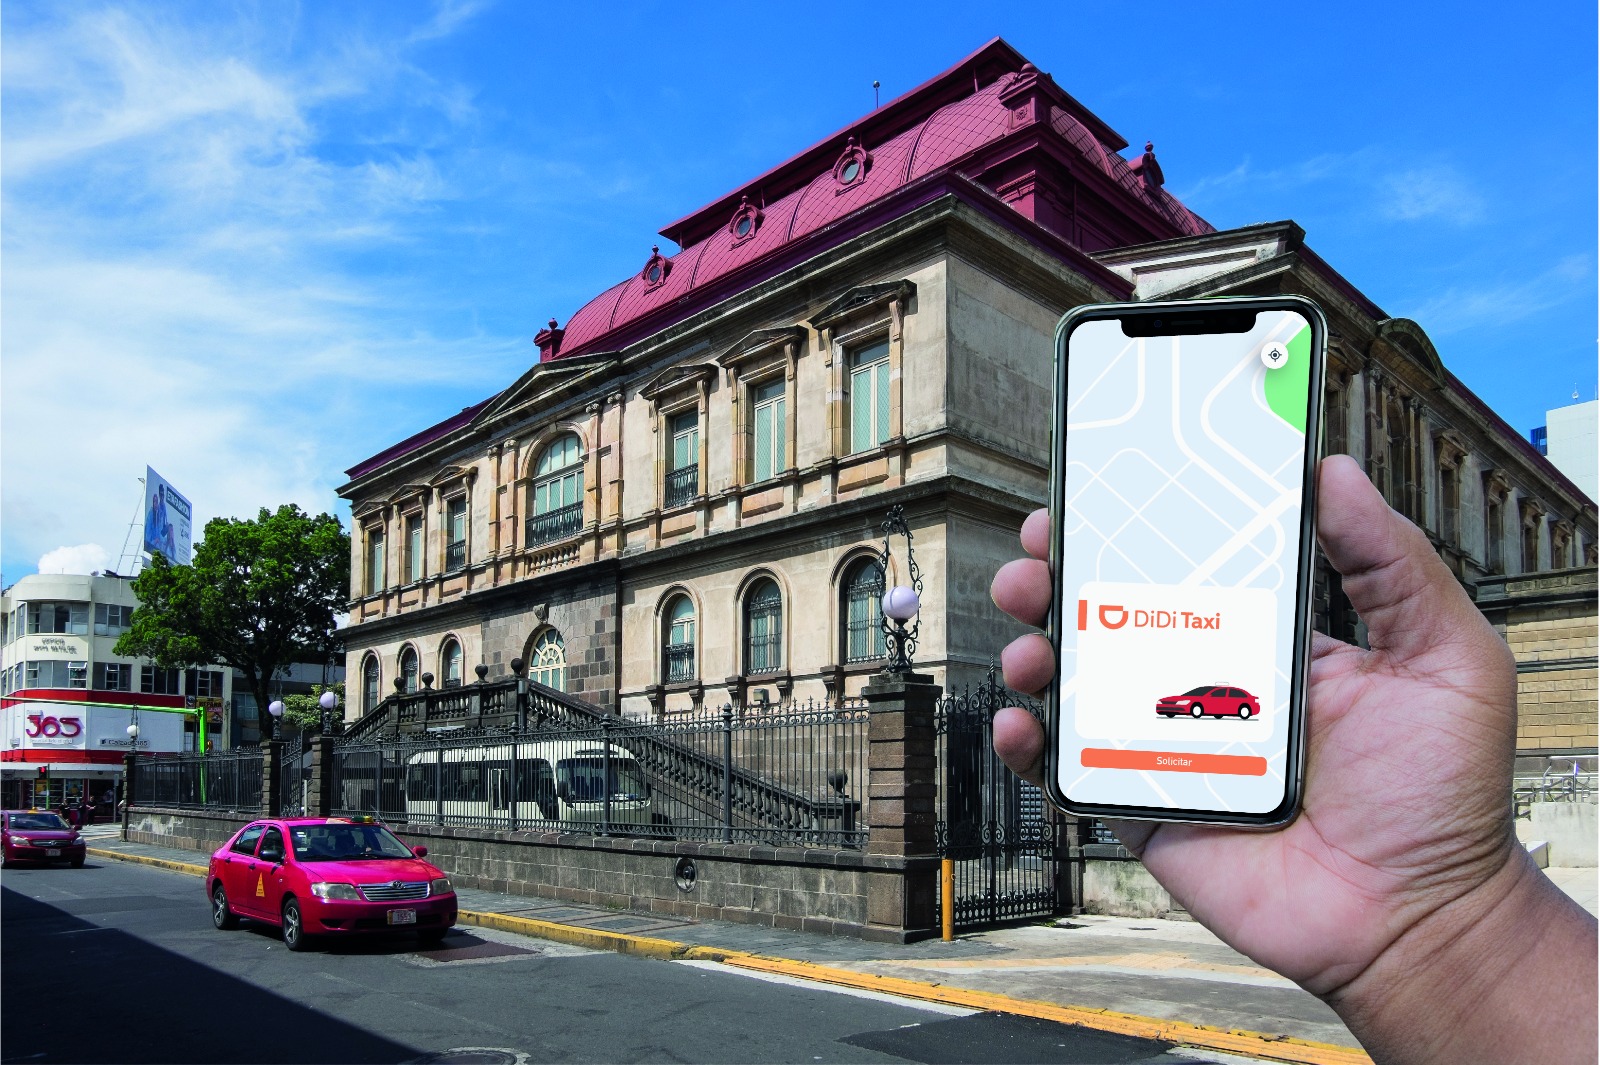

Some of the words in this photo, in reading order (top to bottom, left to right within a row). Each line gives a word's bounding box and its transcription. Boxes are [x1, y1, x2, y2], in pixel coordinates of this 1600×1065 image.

[1134, 609, 1177, 628] DiDi
[1181, 611, 1221, 629] Taxi
[25, 714, 82, 738] 365
[1156, 756, 1193, 767] Solicitar
